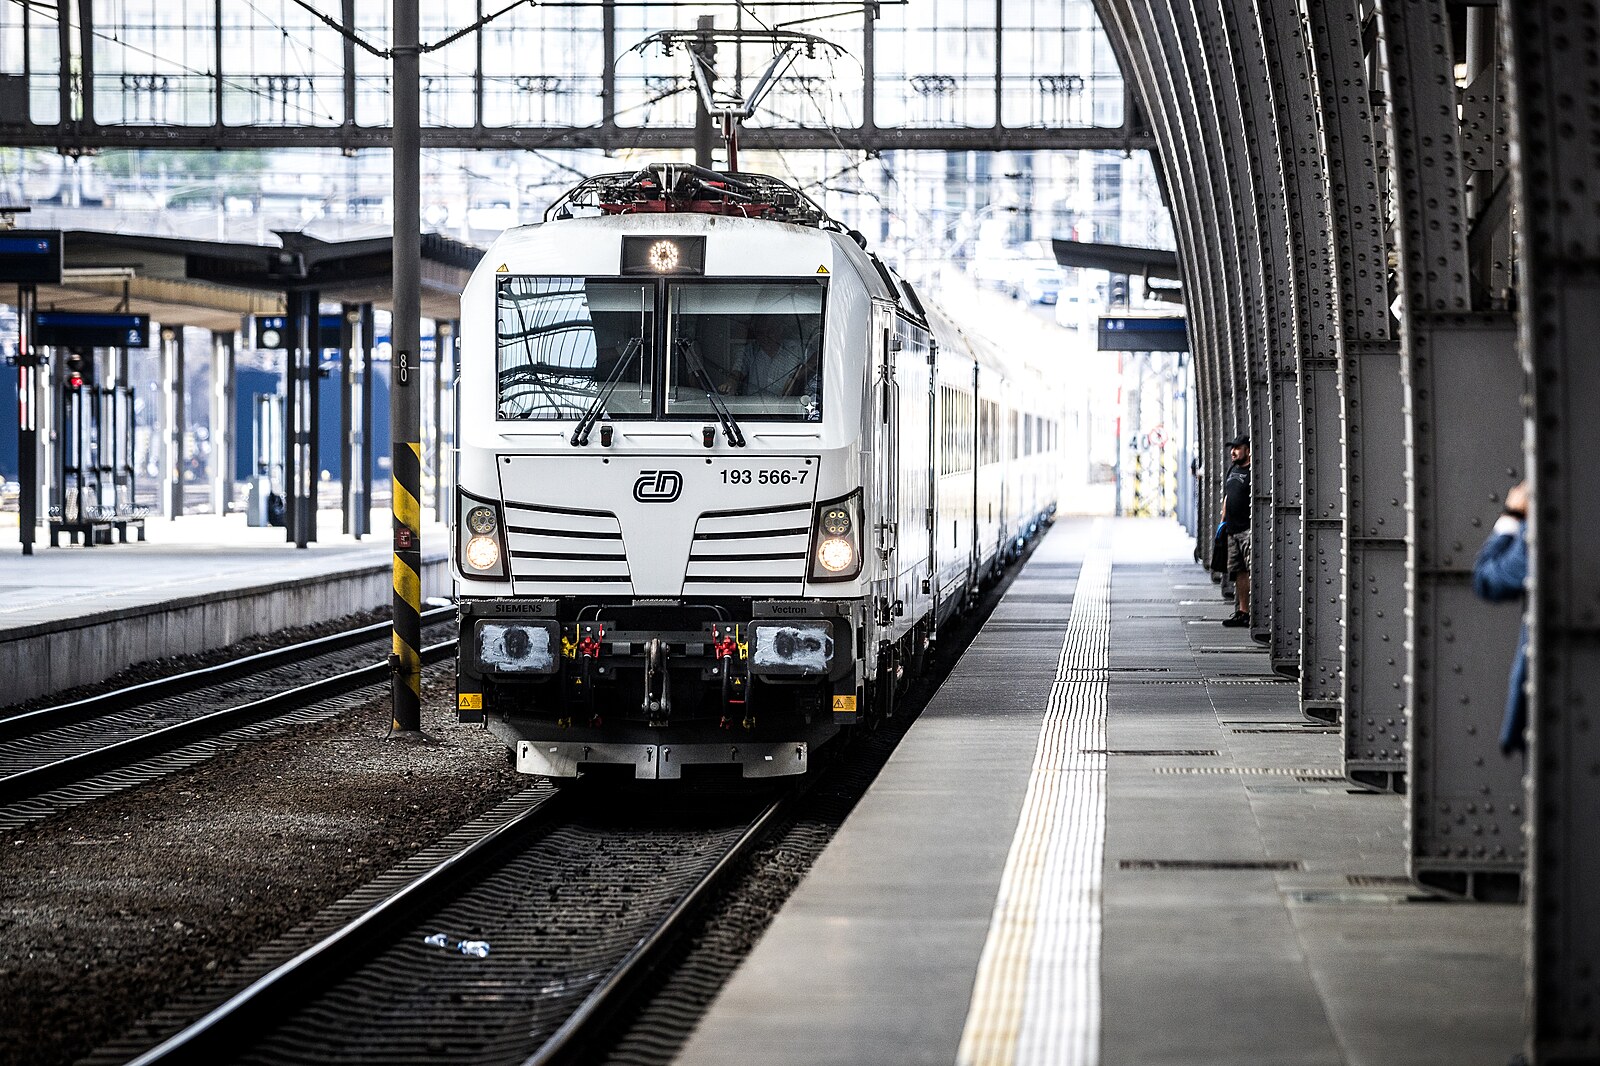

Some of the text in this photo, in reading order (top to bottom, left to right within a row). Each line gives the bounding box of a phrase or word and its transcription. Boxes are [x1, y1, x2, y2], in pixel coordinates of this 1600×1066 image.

[400, 354, 407, 382] 80
[720, 470, 809, 485] 193 566-7
[495, 604, 542, 613] SIEMENS
[771, 605, 807, 614] Vectron
